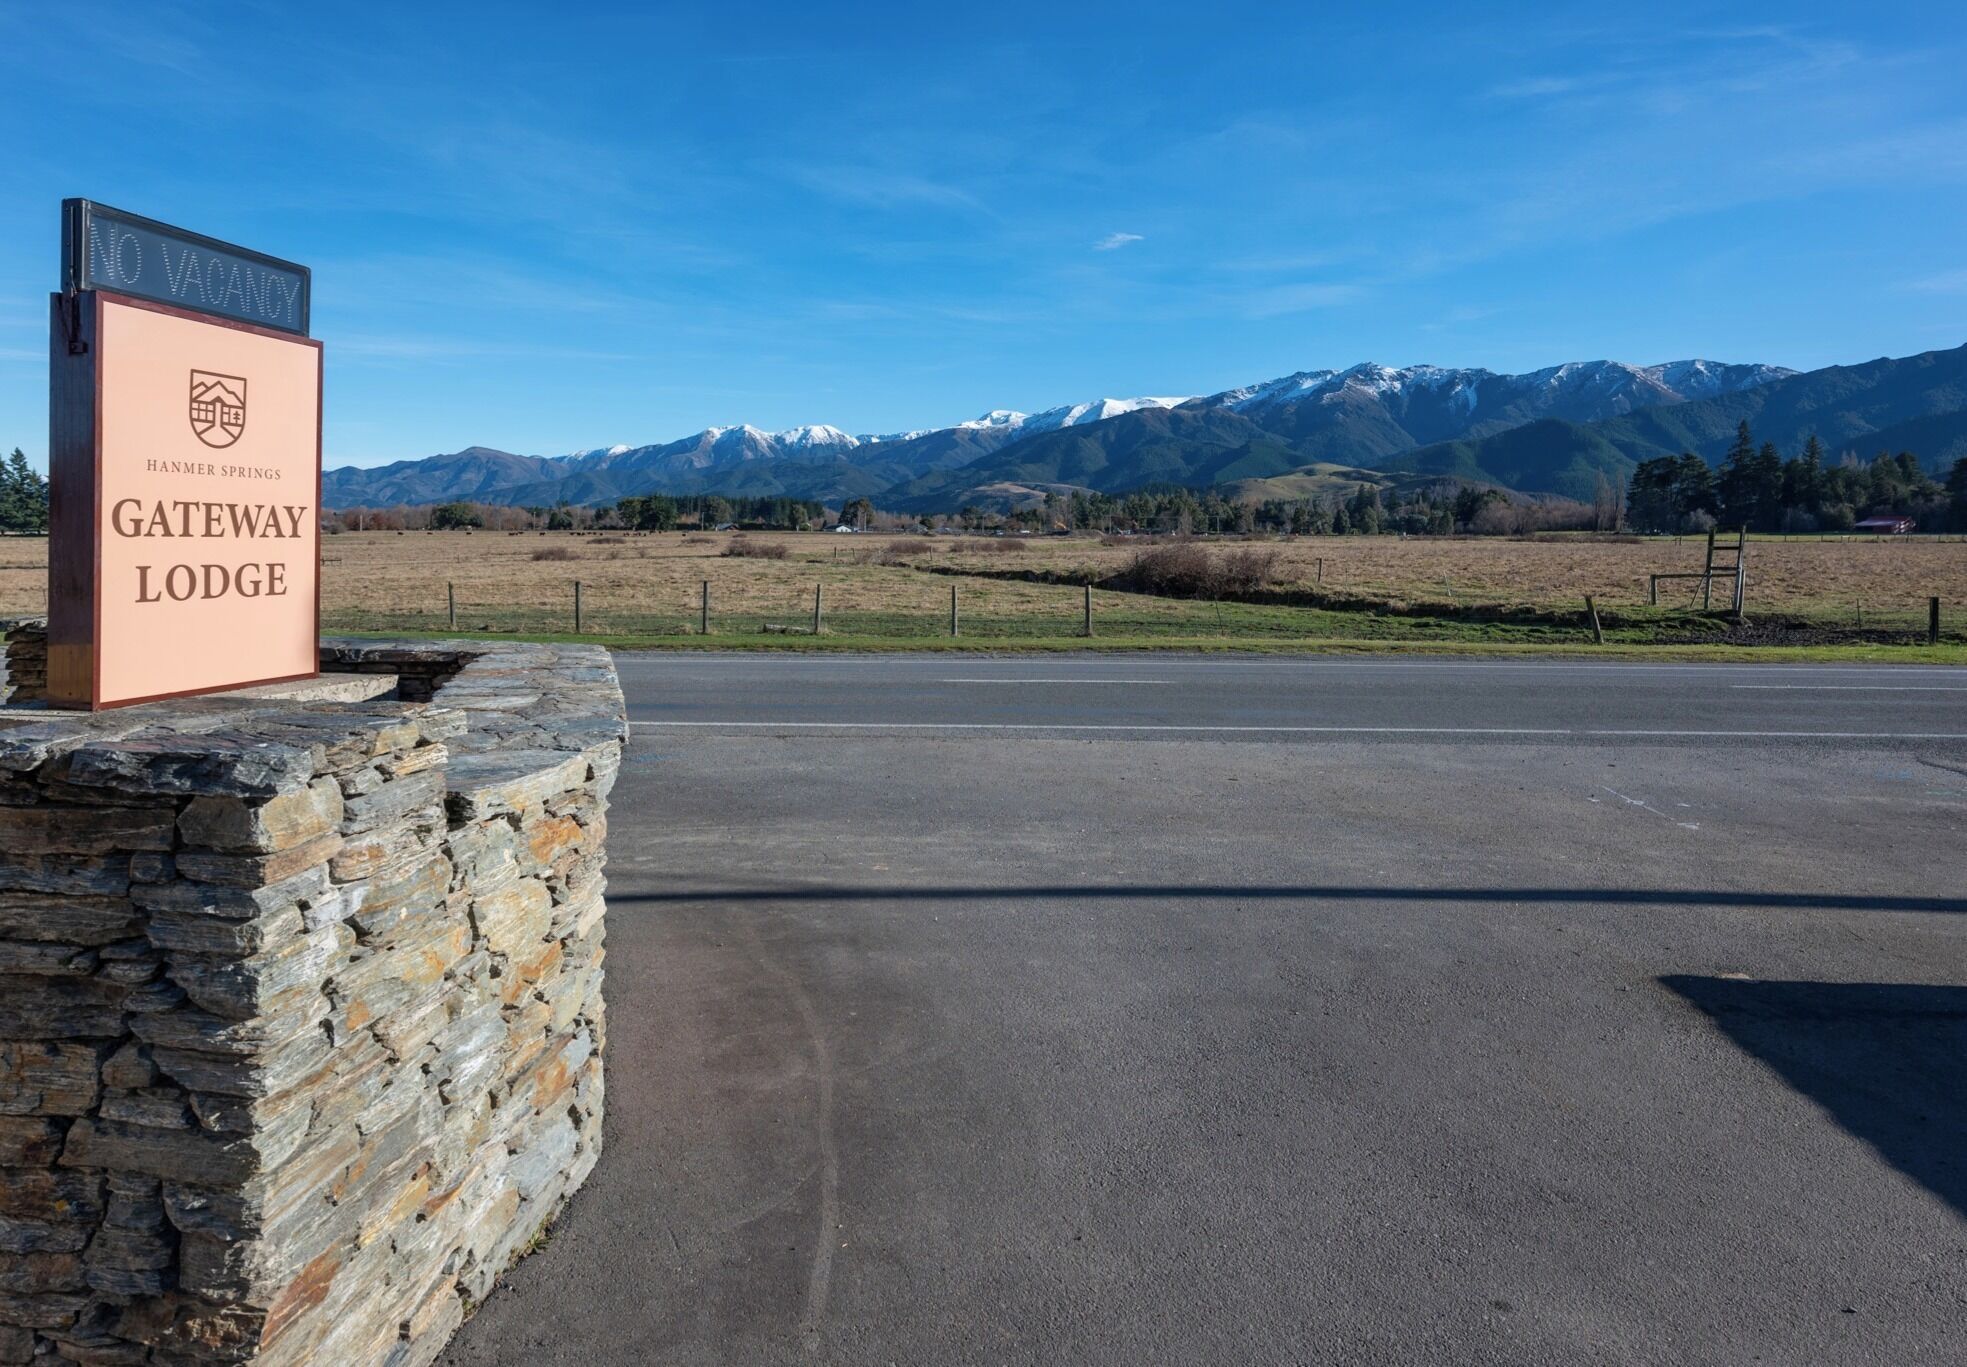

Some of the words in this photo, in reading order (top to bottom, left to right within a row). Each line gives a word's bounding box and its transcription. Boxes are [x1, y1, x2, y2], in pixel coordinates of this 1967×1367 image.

[90, 223, 142, 284] NO
[161, 243, 301, 323] VACANCY
[146, 459, 216, 477] HANMER
[221, 465, 282, 480] SPRINGS
[111, 498, 308, 538] GATEWAY
[135, 563, 288, 603] LODGE
